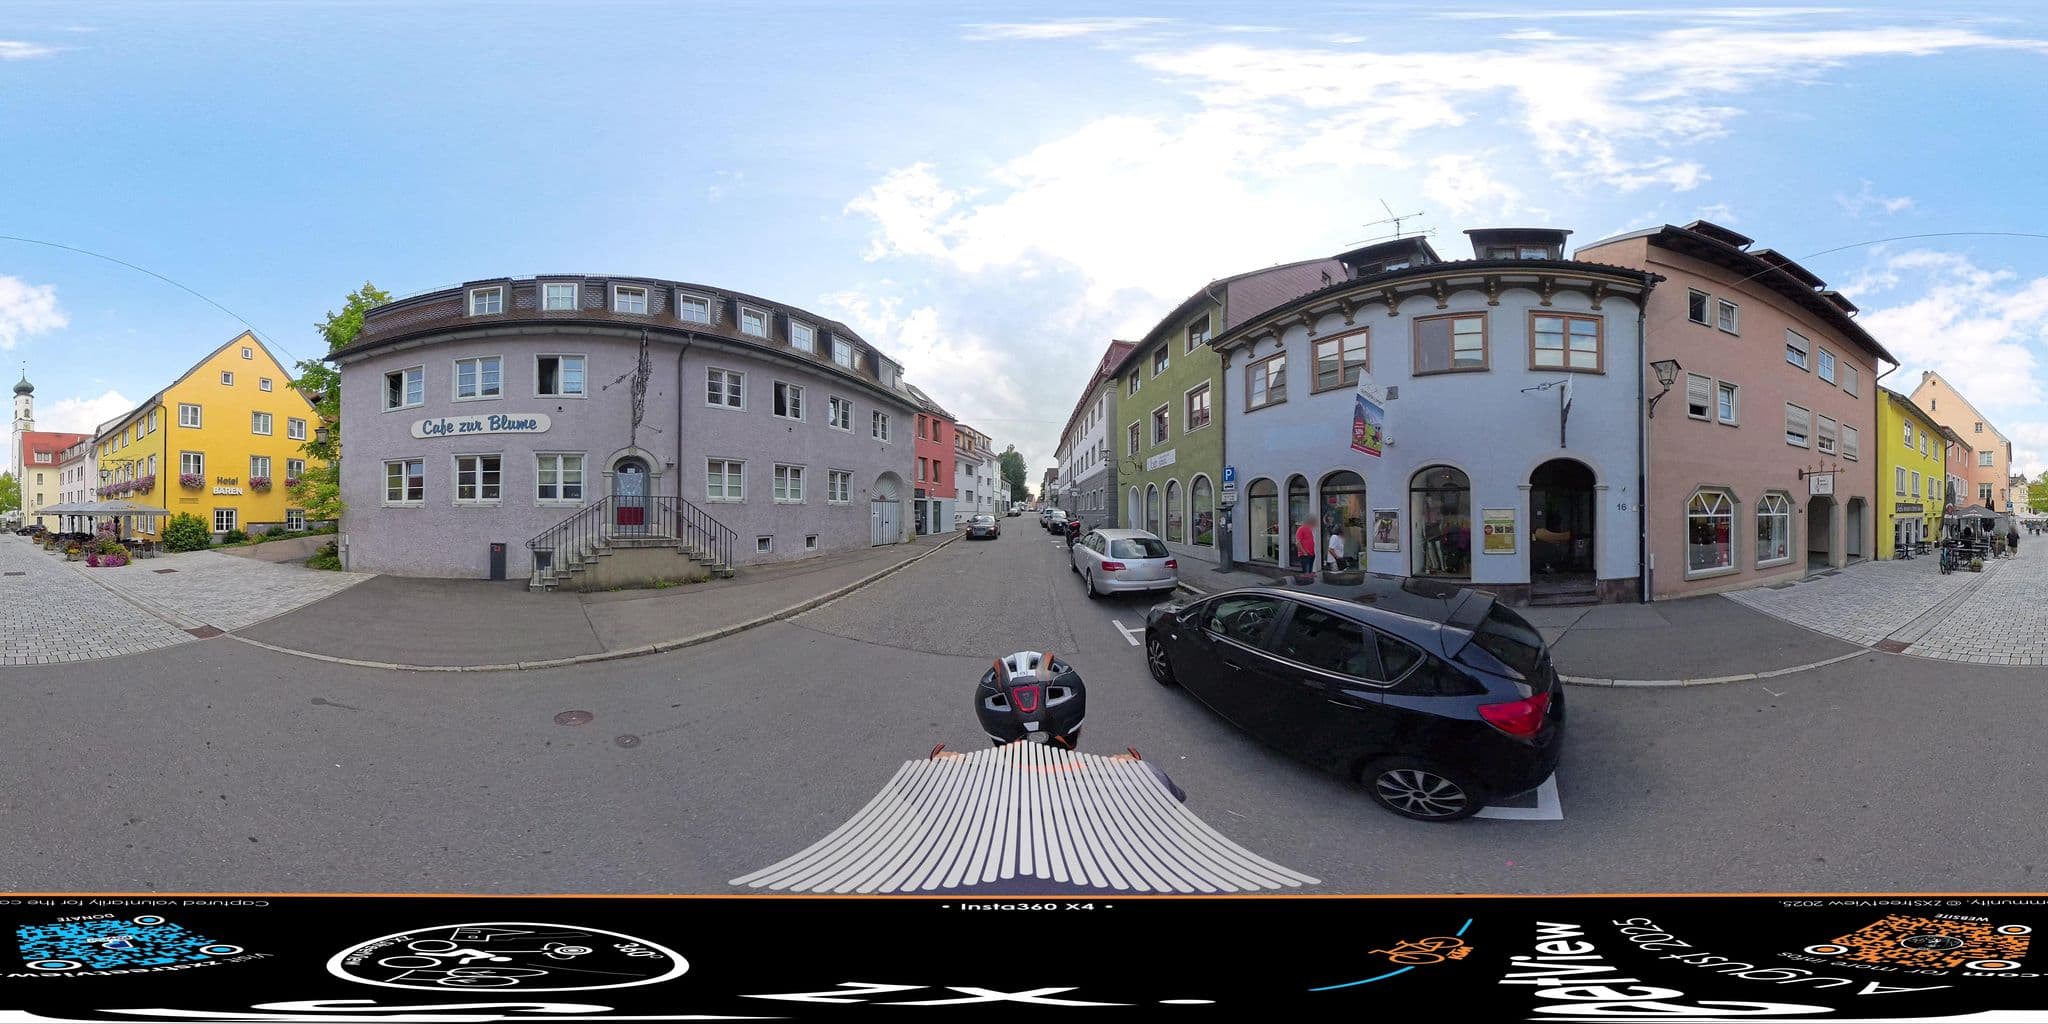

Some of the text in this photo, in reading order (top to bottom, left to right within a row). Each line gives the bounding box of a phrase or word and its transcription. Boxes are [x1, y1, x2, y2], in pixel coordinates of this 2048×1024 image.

[422, 415, 538, 435] Cafe zur Blume
[1225, 469, 1232, 480] P
[217, 476, 239, 485] Hotel
[1616, 503, 1628, 511] 16
